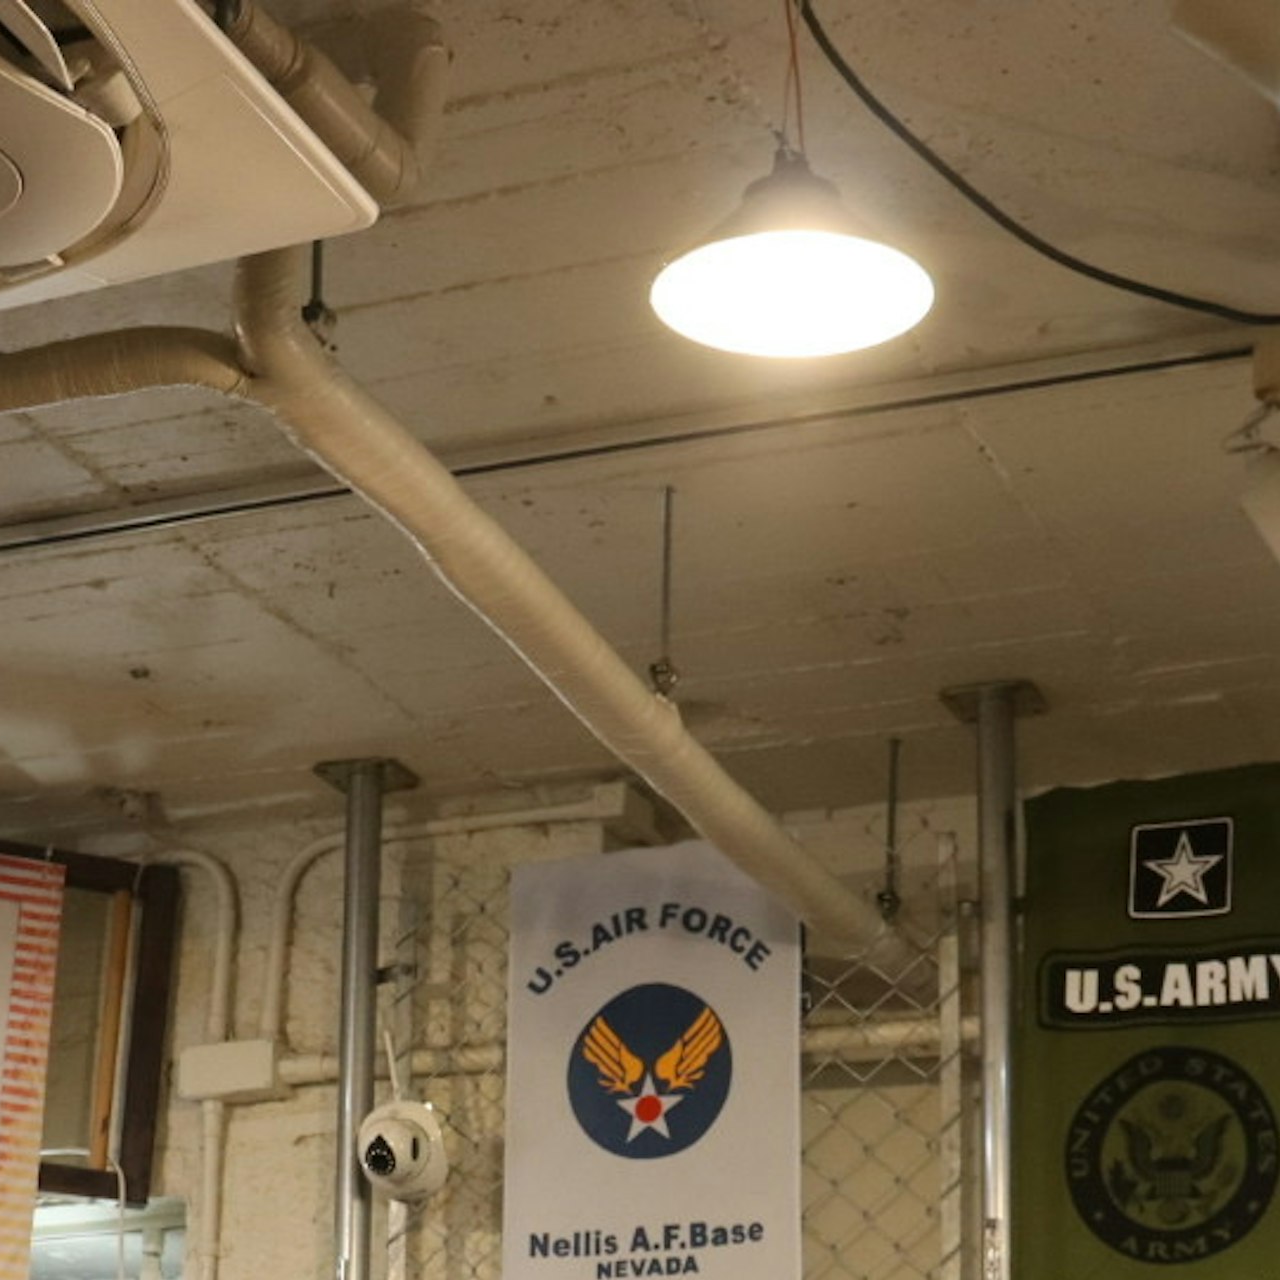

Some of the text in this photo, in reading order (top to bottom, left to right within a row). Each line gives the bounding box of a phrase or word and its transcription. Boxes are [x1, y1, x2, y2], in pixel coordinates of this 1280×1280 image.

[527, 903, 771, 995] U.S.AIR FORCE
[1070, 1056, 1277, 1178] UNITED STATES
[529, 1221, 764, 1258] Nellis A.F.Base
[1119, 1222, 1235, 1260] ARMY
[596, 1256, 699, 1280] NEVADA
